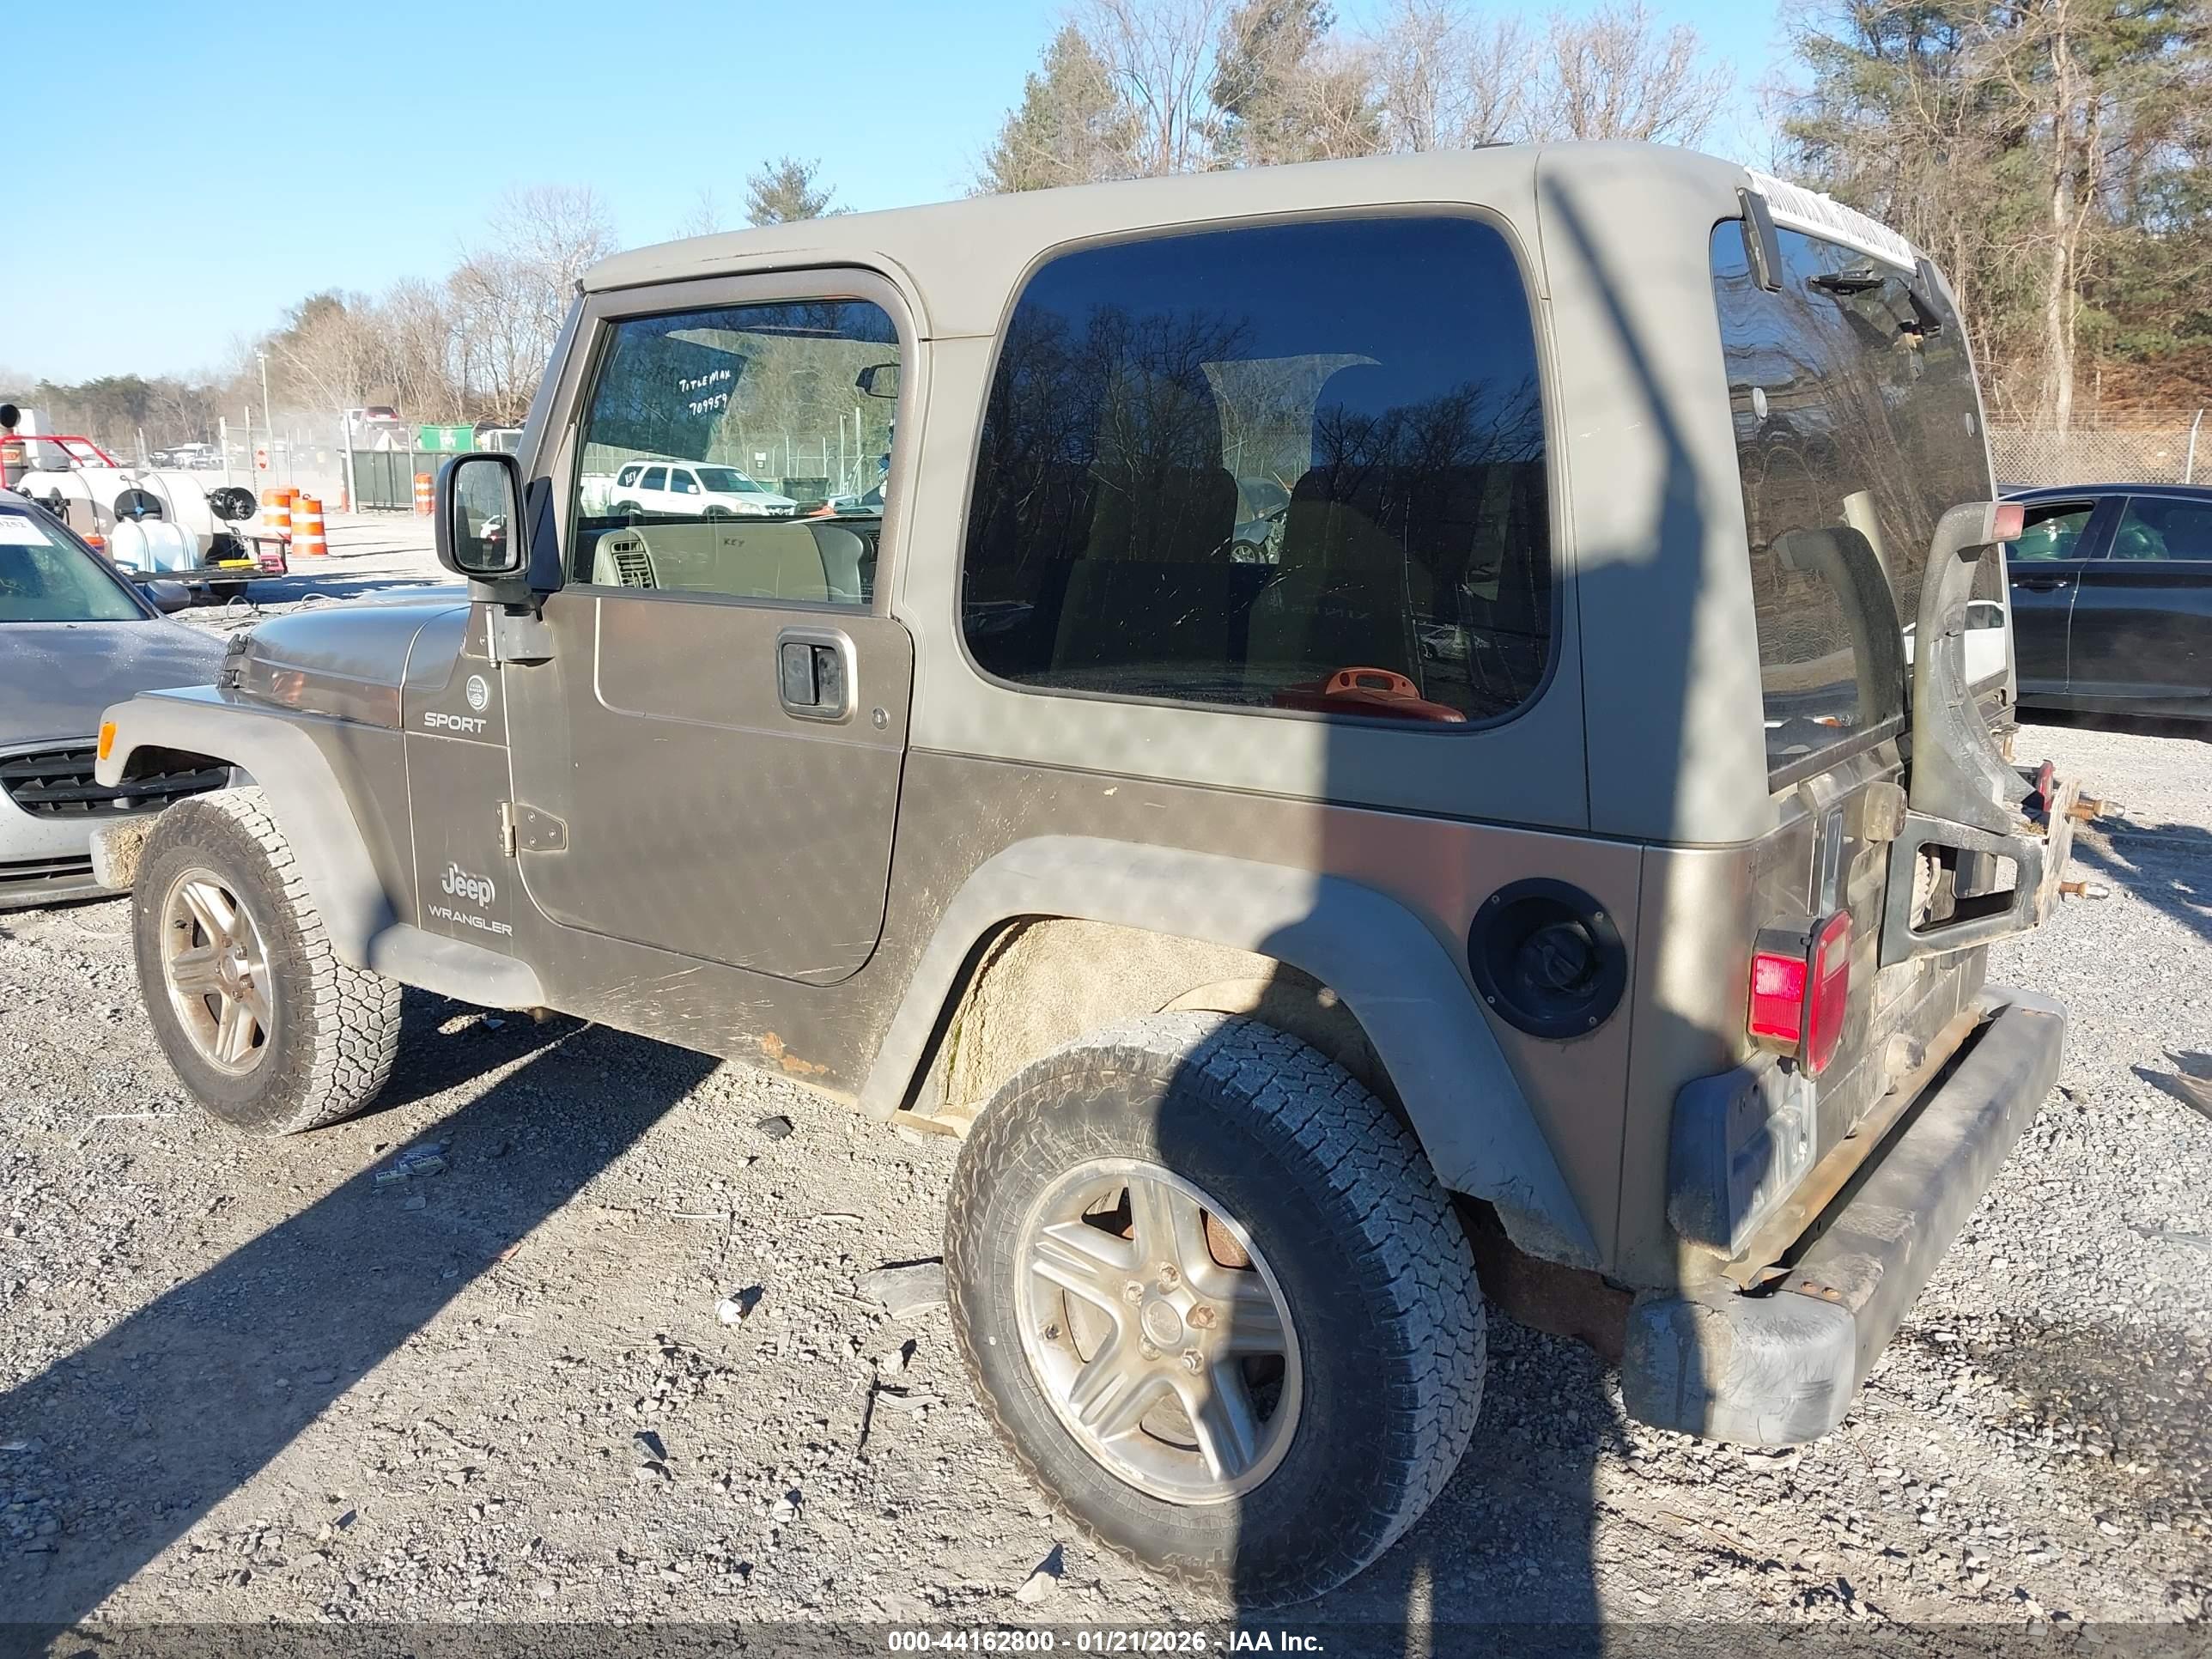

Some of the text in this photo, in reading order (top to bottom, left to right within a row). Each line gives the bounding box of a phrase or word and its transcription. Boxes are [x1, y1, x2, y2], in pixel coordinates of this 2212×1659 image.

[689, 392, 727, 416] 709959
[624, 470, 636, 486] KEY
[723, 537, 745, 548] KEY
[423, 711, 488, 734] SPORT
[441, 866, 492, 908] Jeep
[428, 902, 514, 938] WRANGLER
